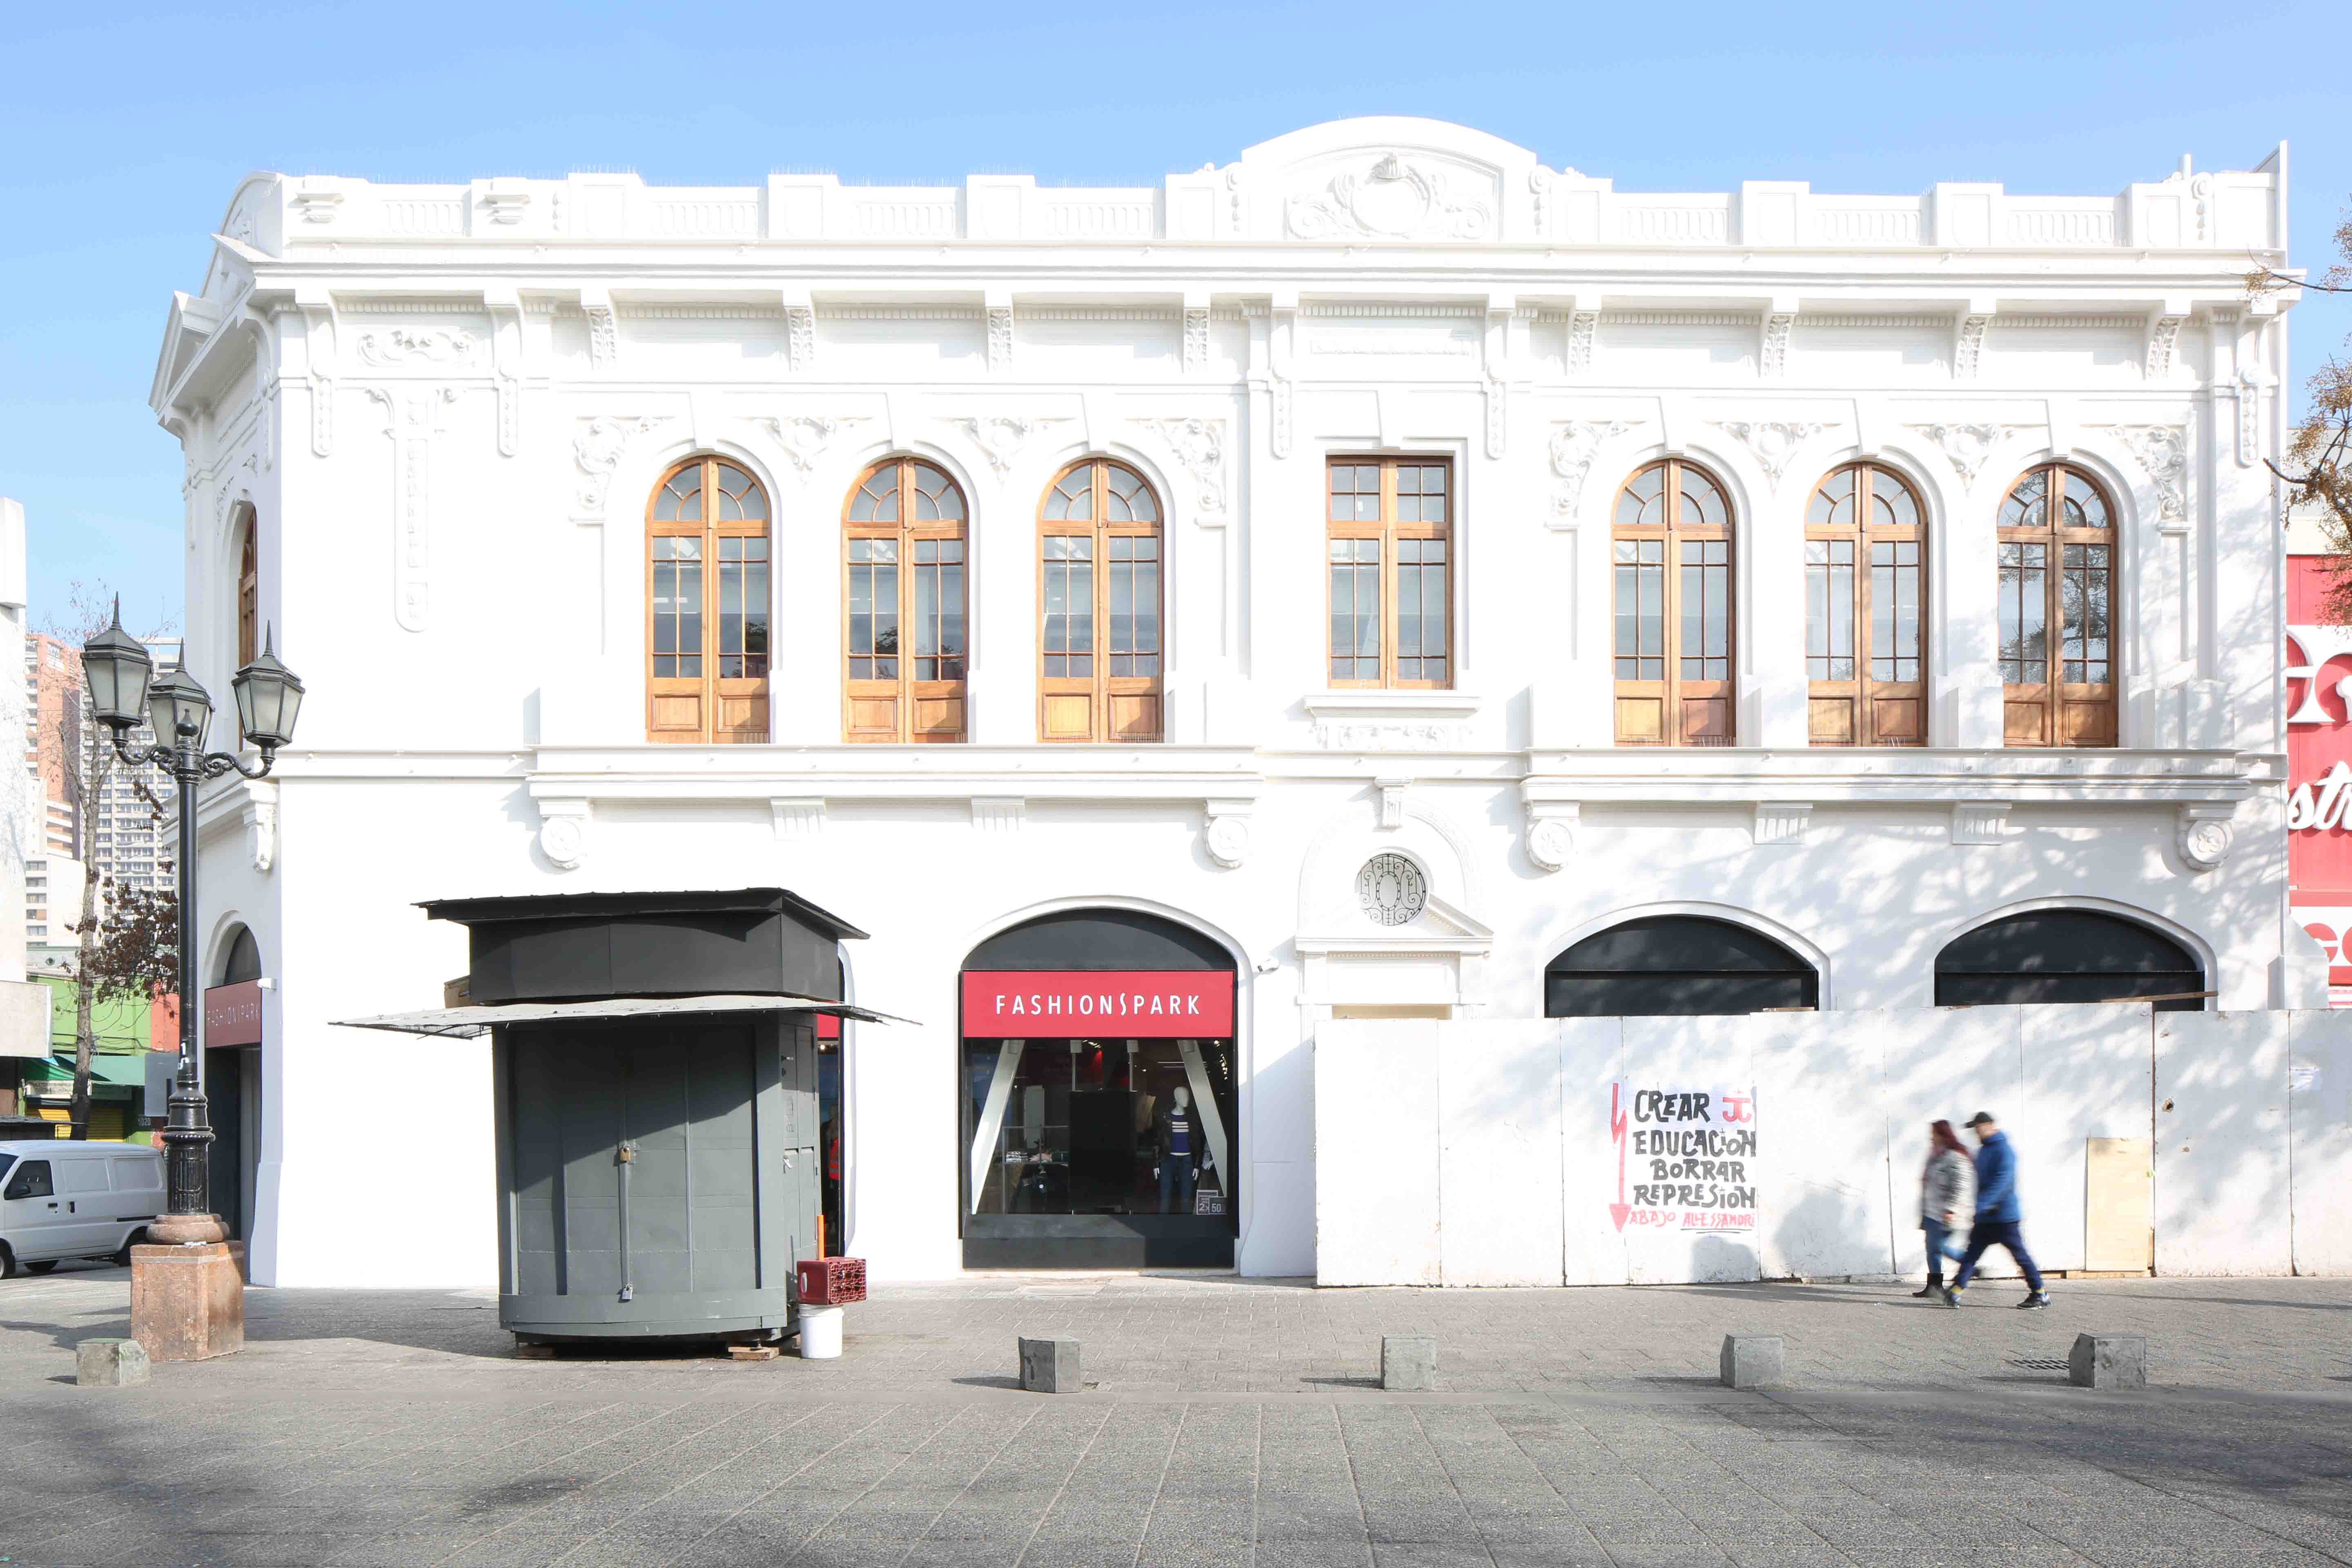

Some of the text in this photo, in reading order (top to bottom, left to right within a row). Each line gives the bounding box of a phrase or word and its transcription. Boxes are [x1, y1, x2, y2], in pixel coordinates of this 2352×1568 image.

[996, 993, 1199, 1016] FASHIONSPARK
[1635, 1089, 1711, 1123] CREAR
[1650, 1159, 1746, 1182] BORRAR
[1629, 1210, 1675, 1227] ABAJO
